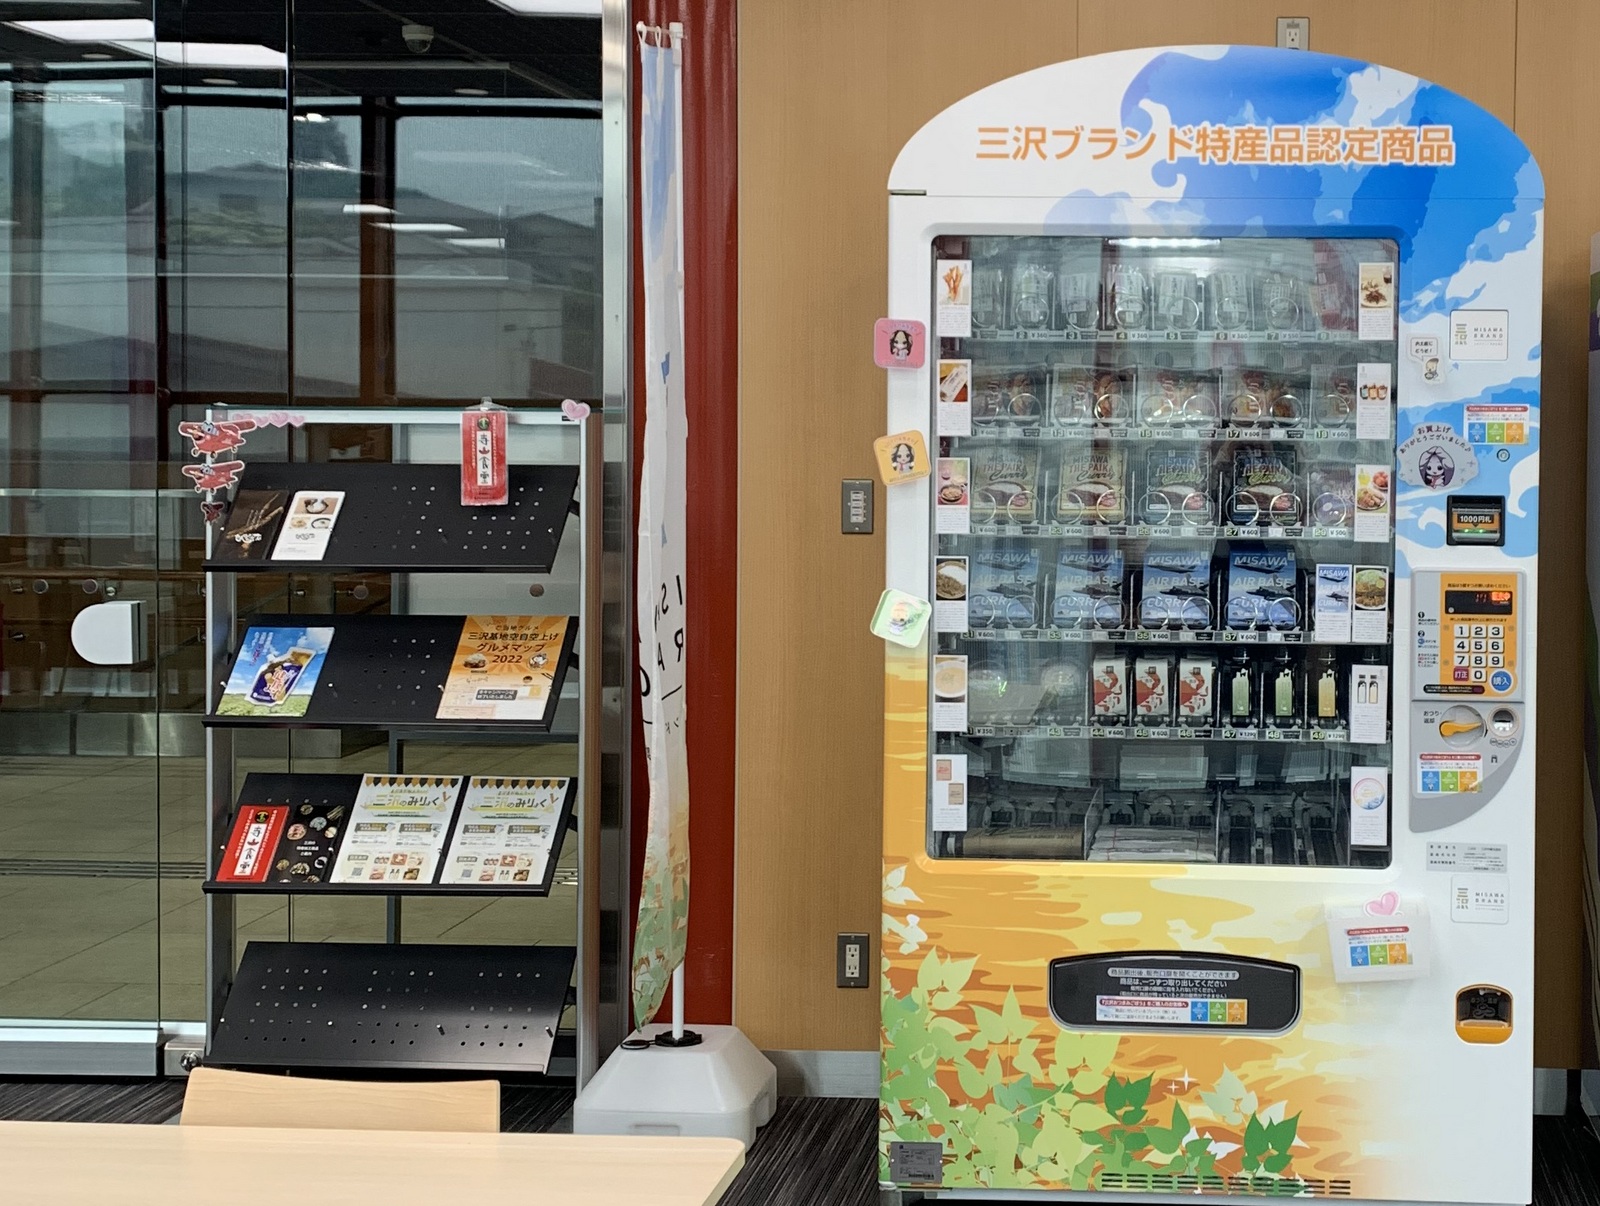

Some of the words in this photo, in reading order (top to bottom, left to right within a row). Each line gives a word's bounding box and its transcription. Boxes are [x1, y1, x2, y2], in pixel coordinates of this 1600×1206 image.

[976, 125, 1455, 165] 三沢ブランド特産品認定商品
[1417, 424, 1452, 435] お買上げ
[1073, 455, 1109, 464] MISAWA
[1069, 464, 1087, 473] THE
[1088, 463, 1114, 473] PAIKA
[989, 468, 1028, 481] Curry
[1076, 470, 1116, 482] Curry
[1460, 515, 1492, 523] 1000円札
[978, 553, 1031, 563] MISAWA
[1062, 554, 1116, 564] MISAWA
[1149, 556, 1201, 566] MISAWA
[1234, 557, 1288, 566] MISAWA
[972, 574, 999, 584] AIR
[1000, 574, 1034, 585] BASE
[1061, 575, 1084, 585] AIR
[1086, 575, 1119, 586] BASE
[1146, 577, 1169, 586] AIR
[1171, 577, 1206, 587] BASE
[1234, 577, 1258, 587] AIR
[1260, 578, 1293, 587] BASE
[495, 624, 539, 632] ご当地グルメ
[1459, 626, 1464, 635] 1
[1474, 626, 1482, 635] 2
[1492, 627, 1500, 636] 3
[468, 632, 560, 642] 三沢基地空自空上げ
[476, 642, 546, 653] グルメマップ
[1457, 641, 1466, 650] 4
[1474, 642, 1482, 650] 5
[1492, 642, 1500, 650] 6
[492, 654, 523, 664] 2022
[1458, 656, 1464, 664] 7
[1474, 656, 1482, 664] 8
[1492, 656, 1500, 665] 9
[1474, 670, 1482, 679] 0
[1493, 674, 1510, 686] 購入
[373, 794, 440, 806] 三沢のみりょく
[480, 796, 547, 808] 三沢のみりょく
[1120, 978, 1228, 988] 商品は、一つずつ取り出してください
